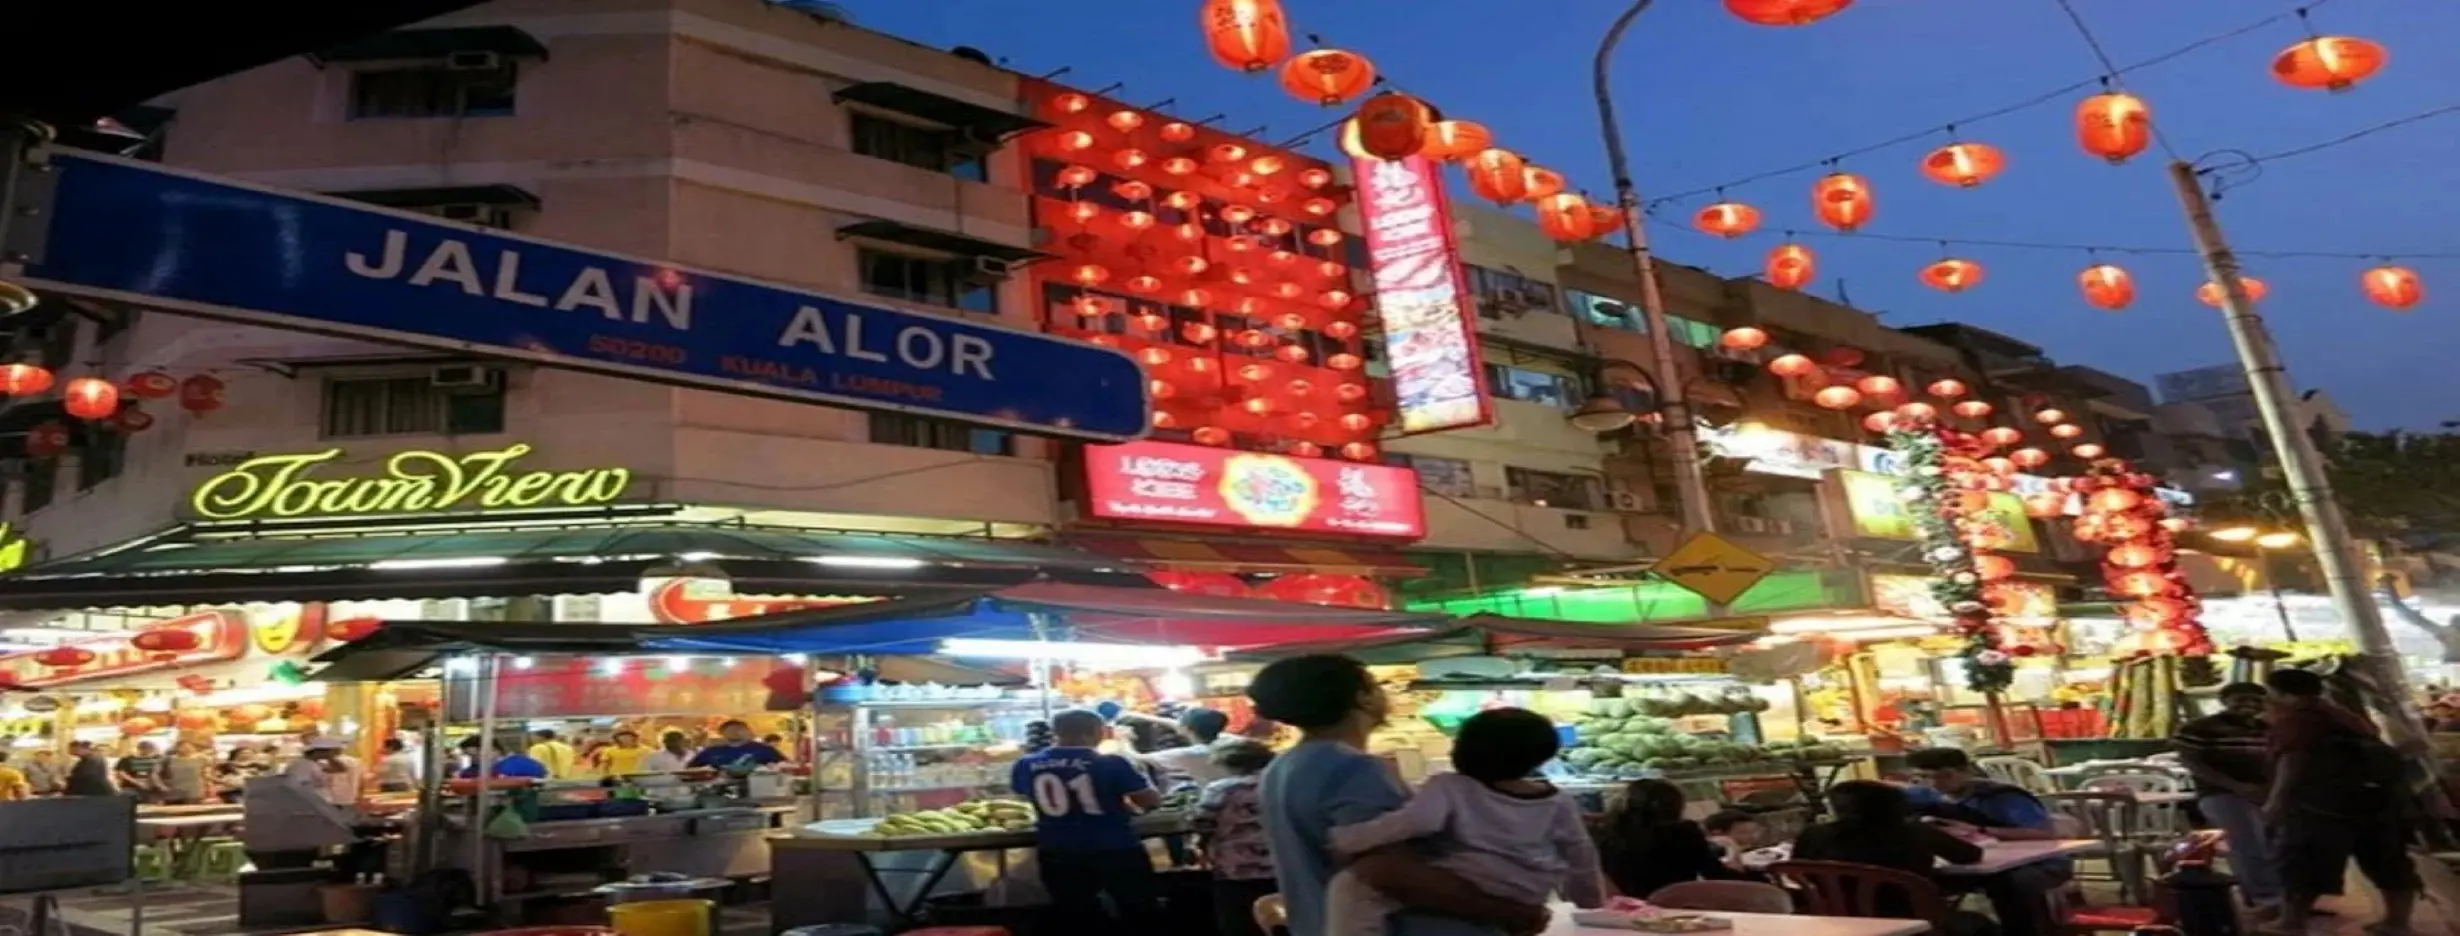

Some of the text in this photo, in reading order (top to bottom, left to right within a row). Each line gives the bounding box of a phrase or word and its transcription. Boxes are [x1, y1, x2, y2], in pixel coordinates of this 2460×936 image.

[345, 229, 997, 381] JALAN ALOR
[718, 354, 819, 387] KUALA
[831, 372, 944, 400] LUMPUR
[1033, 771, 1105, 816] 01
